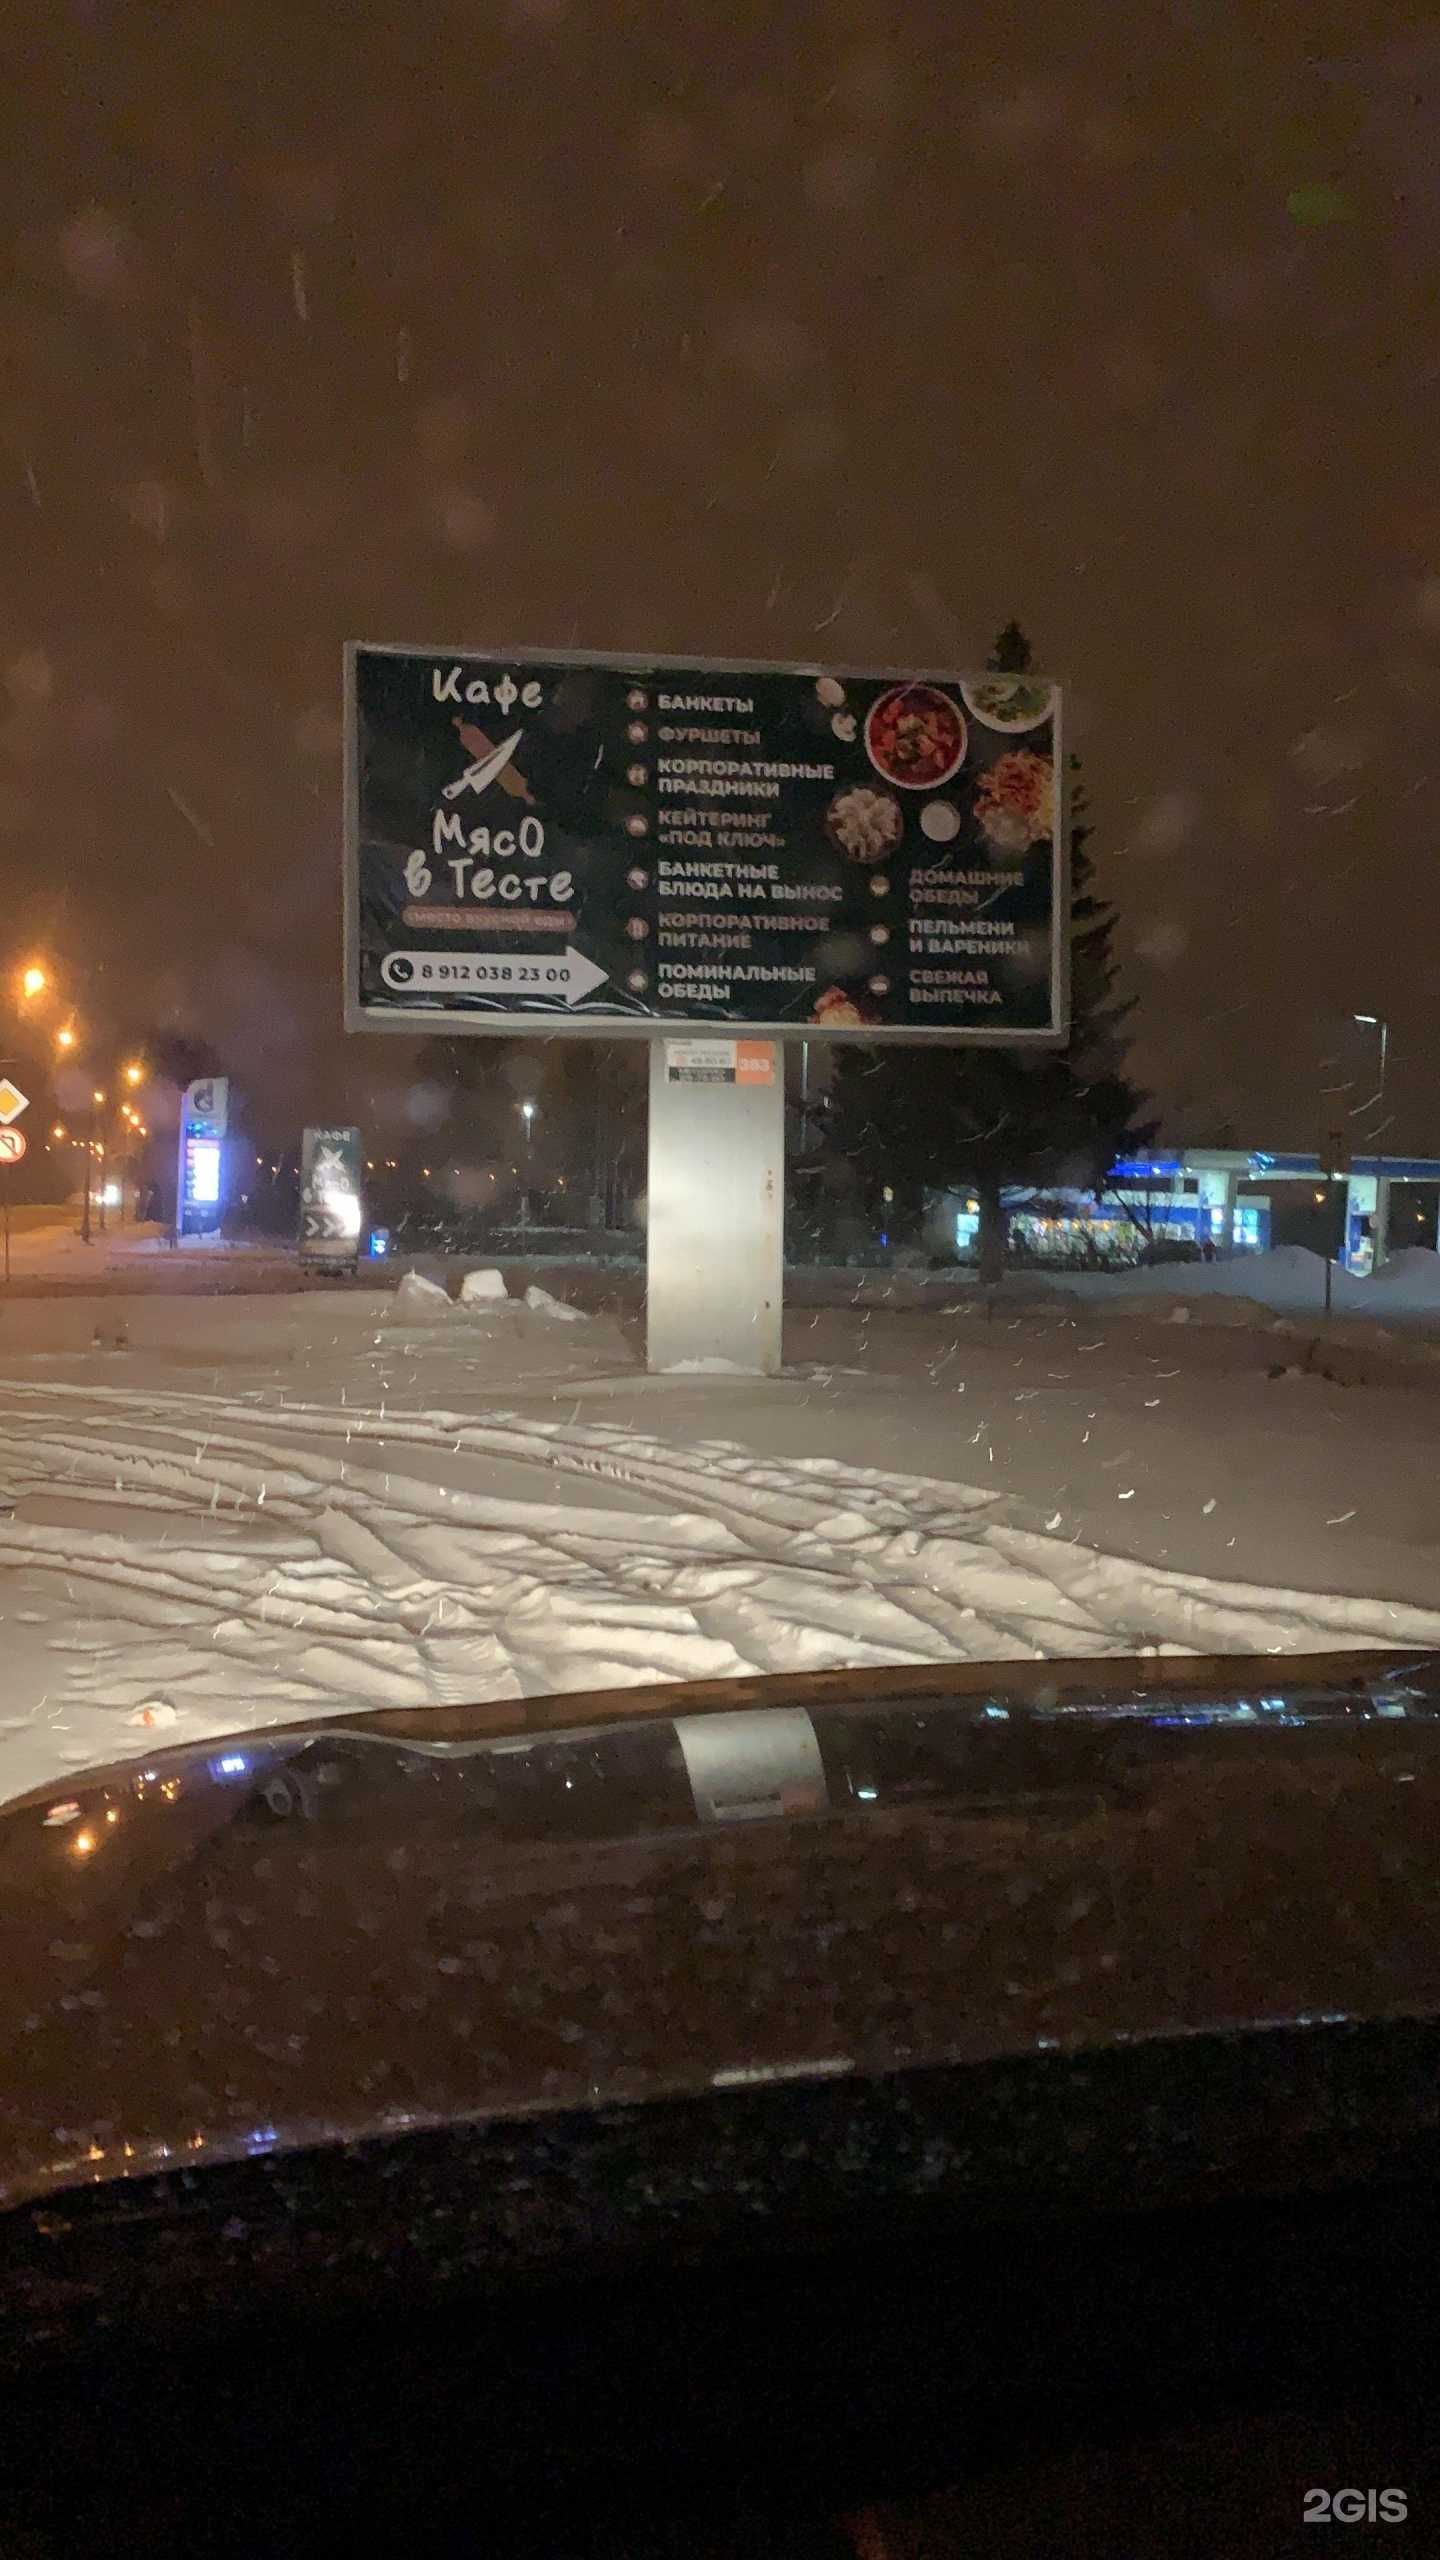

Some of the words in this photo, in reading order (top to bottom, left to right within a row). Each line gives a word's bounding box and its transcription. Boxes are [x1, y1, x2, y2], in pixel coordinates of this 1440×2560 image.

[432, 666, 543, 715] Кафе
[657, 694, 754, 713] БАНКЕТЫ
[657, 726, 761, 745] ФУРШЕТЫ
[657, 758, 835, 780] КОРПОРАТИВНЫЕ
[658, 778, 780, 798] ПРАЗДНИКИ
[658, 807, 772, 828] КЕЙТЕРИНГ
[658, 830, 712, 848] «ПОД
[717, 831, 786, 848] КЛЮЧ»
[447, 857, 575, 902] Тесте
[657, 860, 780, 880] БАНКЕТНЫЕ
[909, 868, 1024, 887] ДОМАШНИЕ
[657, 880, 734, 900] БЛЮДА
[738, 883, 766, 899] НА
[771, 885, 843, 901] ВЫНОС
[909, 888, 979, 905] ОБЕДЫ
[658, 912, 831, 931] КОРПОРАТИВНОЕ
[909, 918, 1015, 935] ПЕЛЬМЕНИ
[658, 932, 752, 949] ПИТАНИЕ
[909, 937, 923, 953] И
[927, 938, 1030, 954] ВАРЕНИКИ
[422, 965, 433, 979] 8
[439, 965, 471, 979] 912
[476, 966, 513, 981] 038
[518, 967, 540, 981] 23
[546, 968, 571, 982] 00
[658, 963, 816, 982] ПОМИНАЛЬНЫЕ
[909, 968, 989, 985] СВЕЖАЯ
[658, 983, 731, 1001] ОБЕДЫ
[909, 987, 1003, 1004] ВЫПЕЧКА
